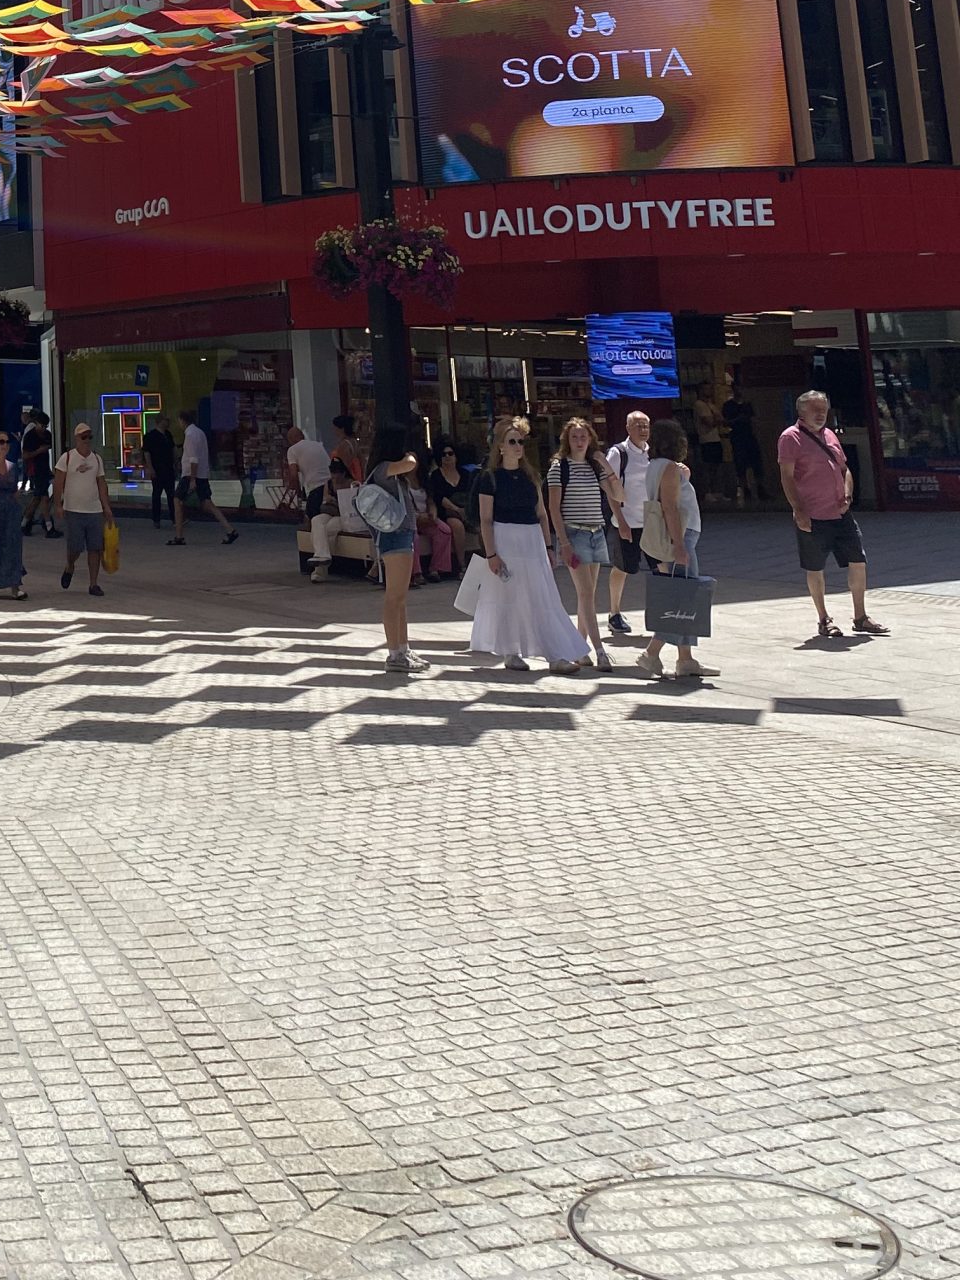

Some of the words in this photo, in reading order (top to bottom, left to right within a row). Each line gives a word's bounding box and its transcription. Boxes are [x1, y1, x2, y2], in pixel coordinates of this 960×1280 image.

[501, 47, 693, 88] SCOTTA
[572, 107, 588, 117] 2a
[592, 105, 635, 120] planta
[115, 208, 143, 226] Grup
[464, 198, 776, 240] UAILODUTYFREE
[244, 370, 275, 382] Winston
